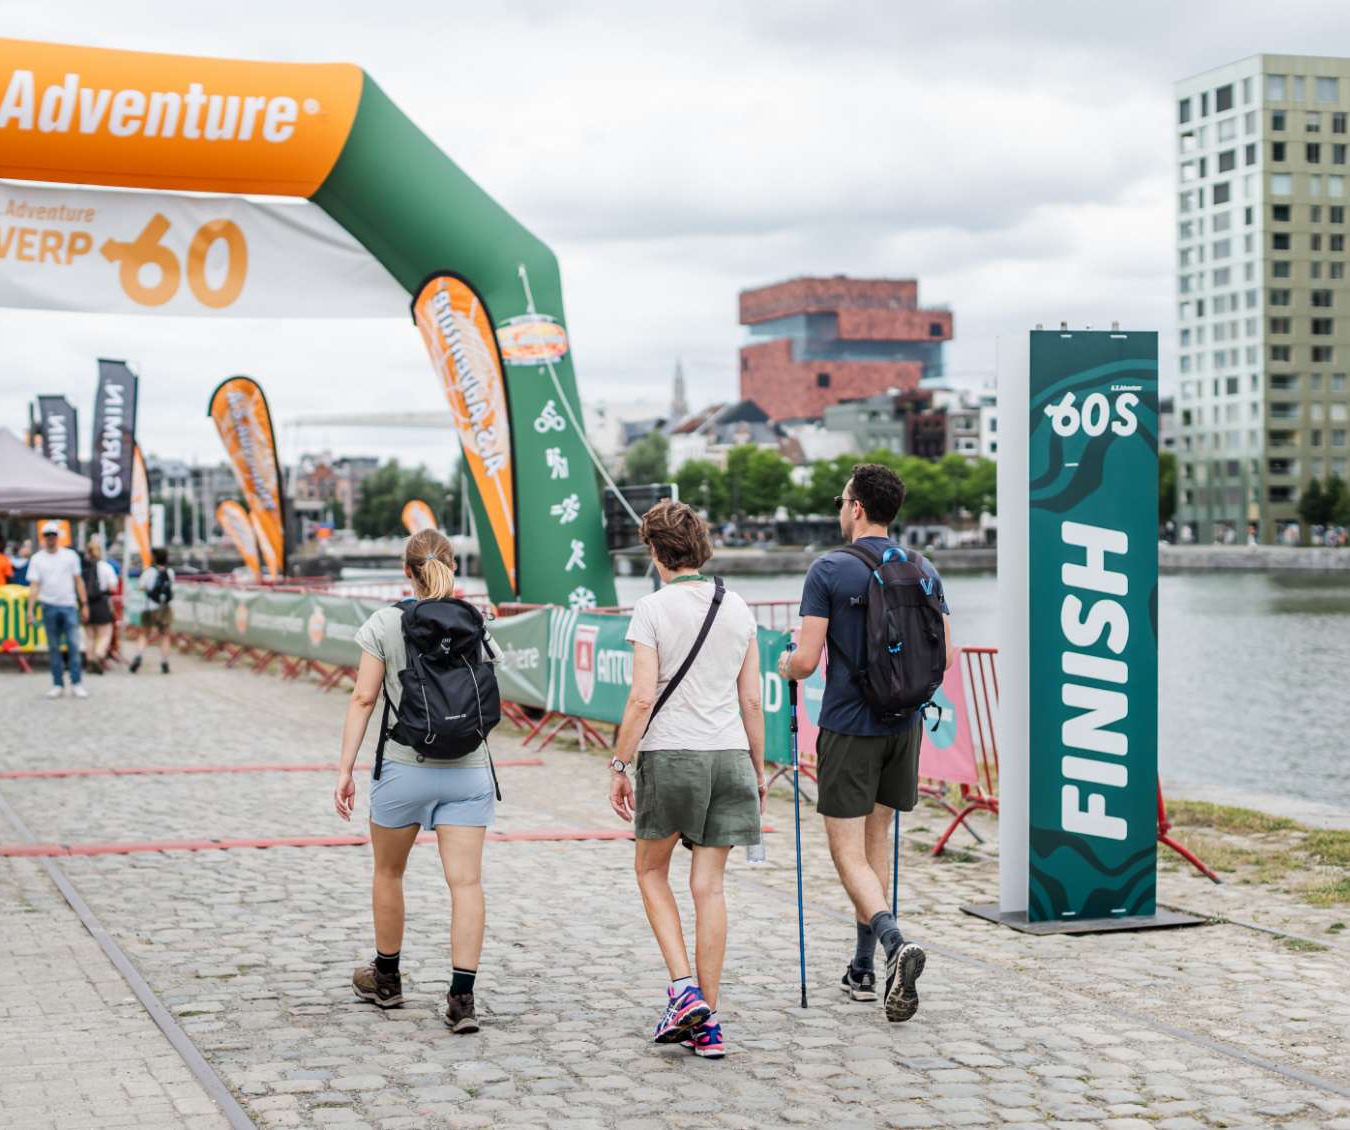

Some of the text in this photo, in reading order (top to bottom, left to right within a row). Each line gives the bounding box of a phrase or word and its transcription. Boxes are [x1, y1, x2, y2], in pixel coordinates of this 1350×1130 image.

[100, 212, 249, 309] 60
[1044, 391, 1140, 437] 60S
[1060, 520, 1130, 841] FINISH
